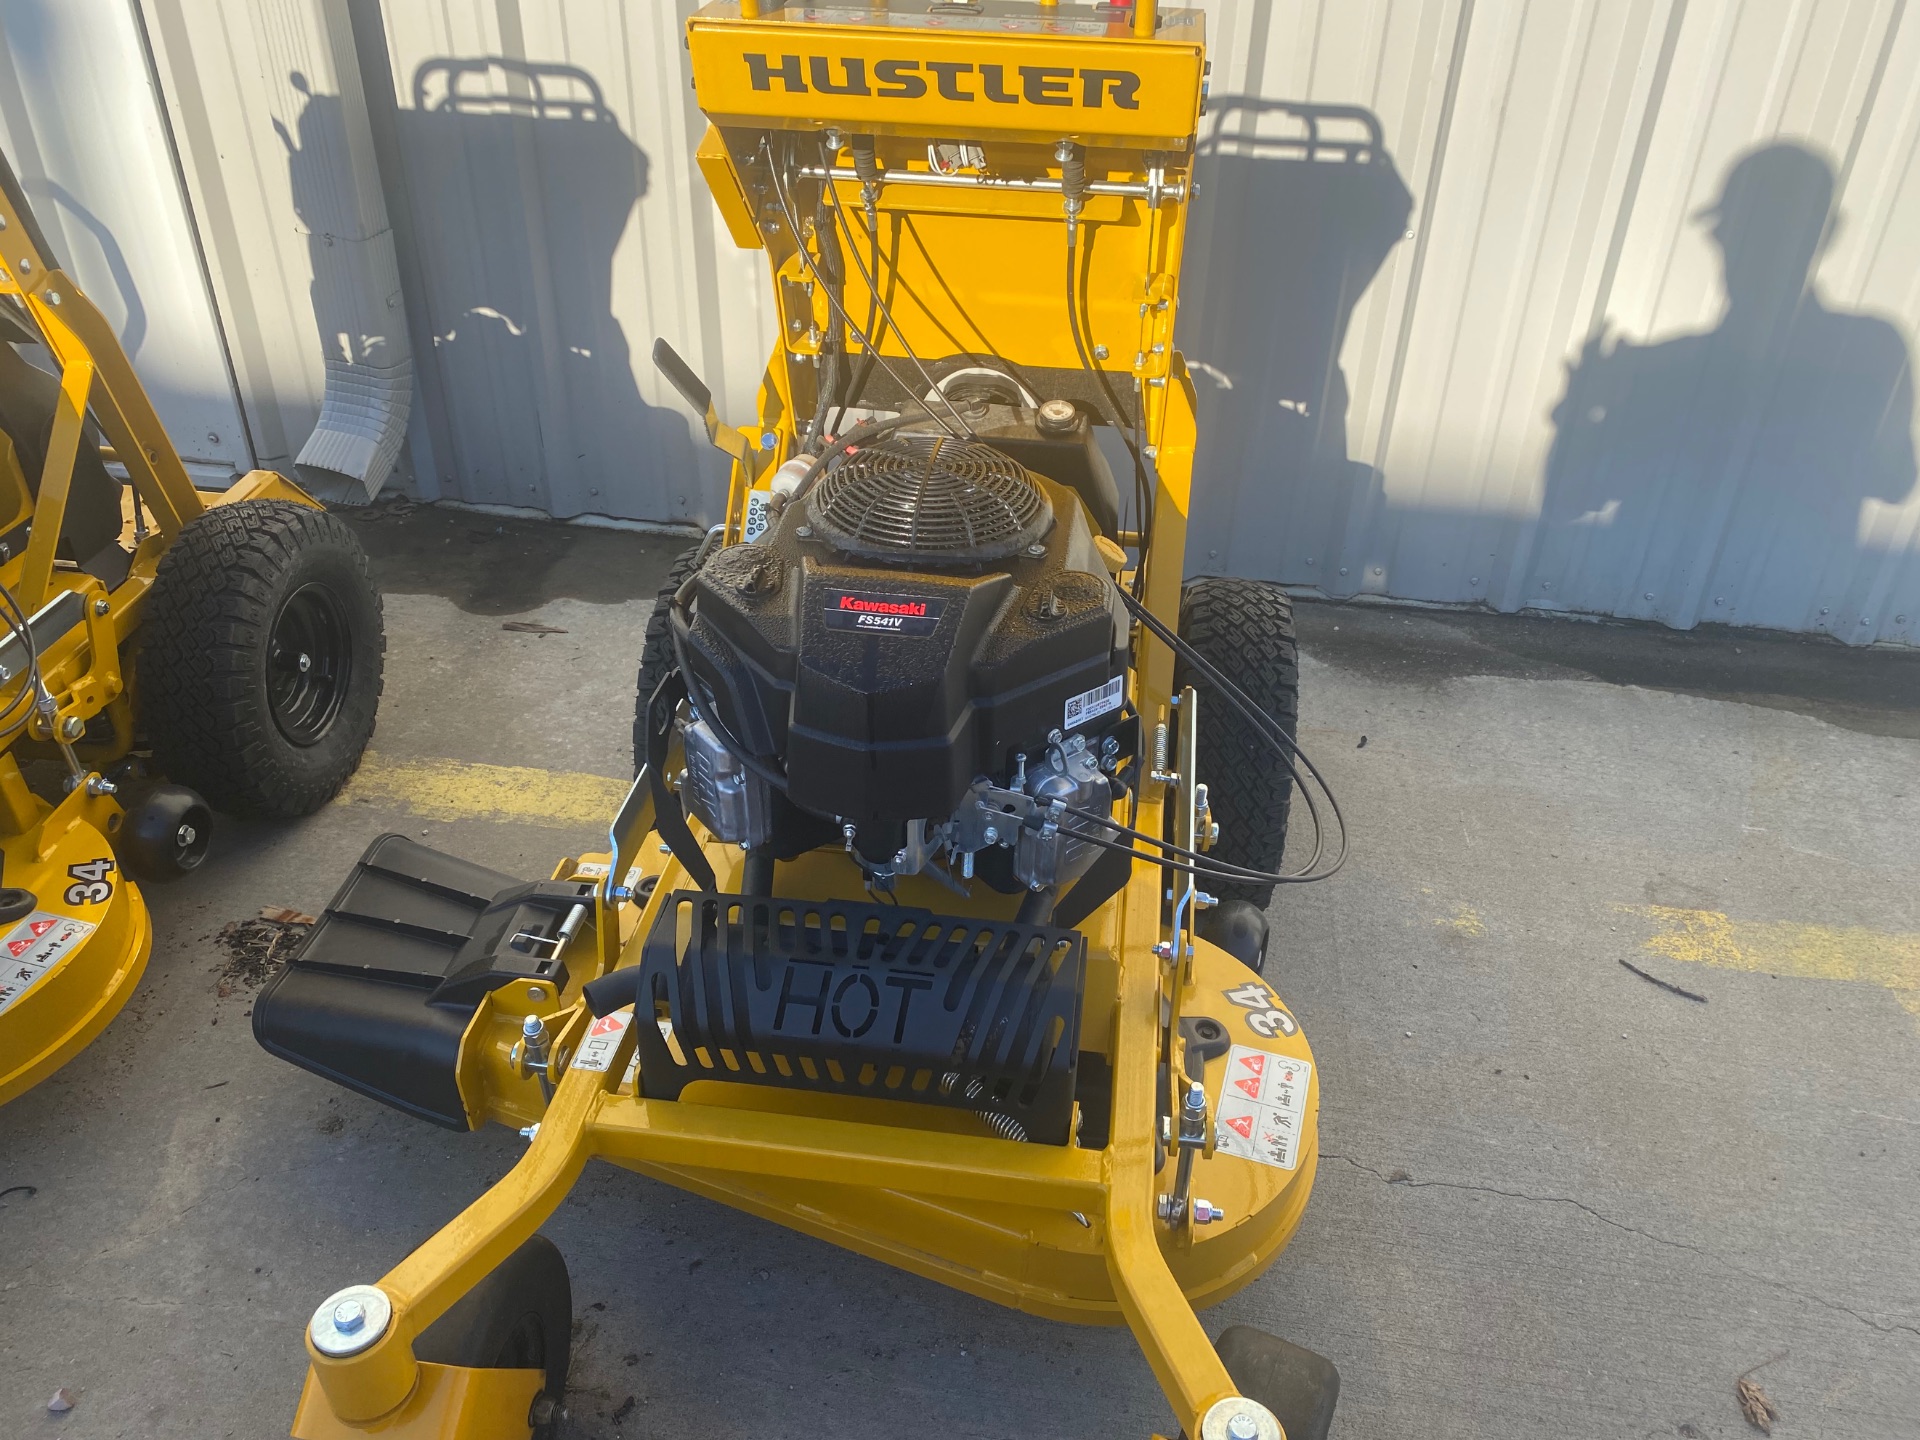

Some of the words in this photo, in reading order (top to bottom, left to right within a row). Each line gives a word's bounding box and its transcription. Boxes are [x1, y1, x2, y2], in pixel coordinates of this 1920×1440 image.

[743, 53, 1141, 109] HUSTLER
[839, 596, 926, 616] Kawasaki
[857, 614, 903, 627] FS541V
[63, 857, 116, 906] 34
[773, 965, 933, 1044] HOT
[1221, 982, 1298, 1038] 34
